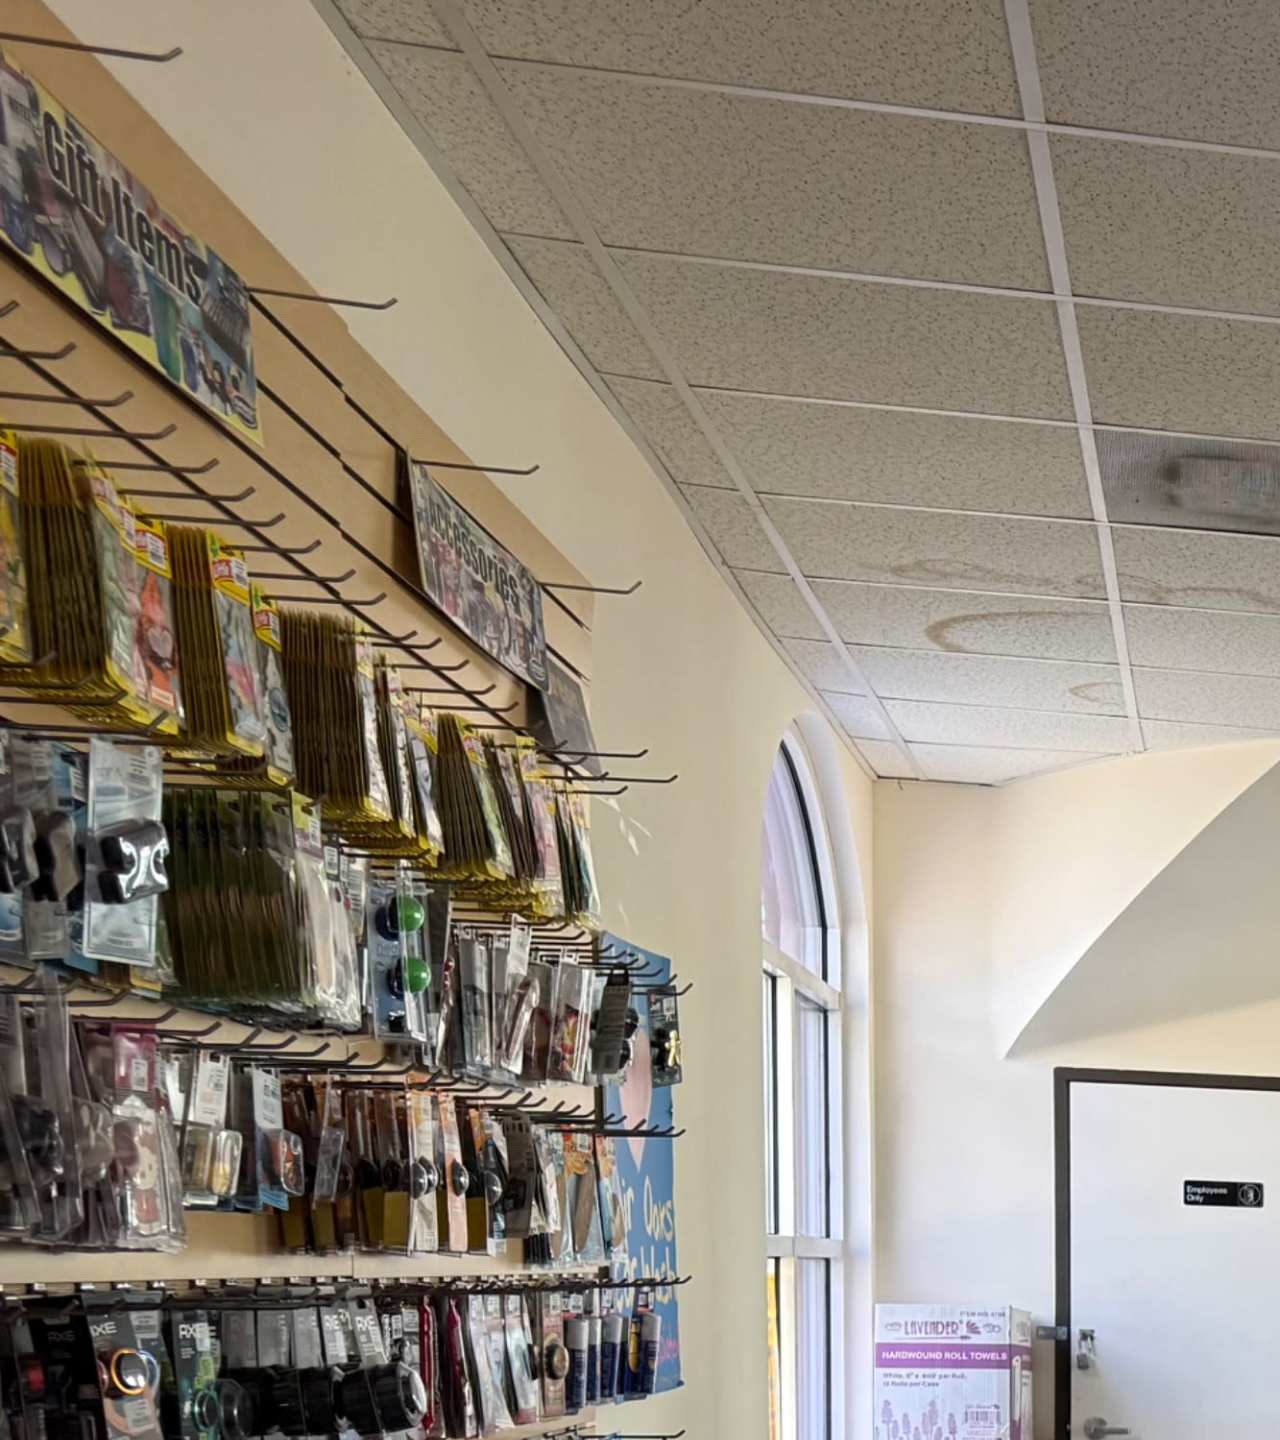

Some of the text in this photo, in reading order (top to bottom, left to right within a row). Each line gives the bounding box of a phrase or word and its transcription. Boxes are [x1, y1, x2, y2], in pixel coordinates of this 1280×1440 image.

[43, 110, 208, 306] Gift Items
[1186, 1185, 1228, 1195] Employees
[1186, 1194, 1204, 1203] Only
[904, 1319, 960, 1336] LAVENDER
[882, 1351, 1008, 1361] HARDWOUND ROLL TOWELS
